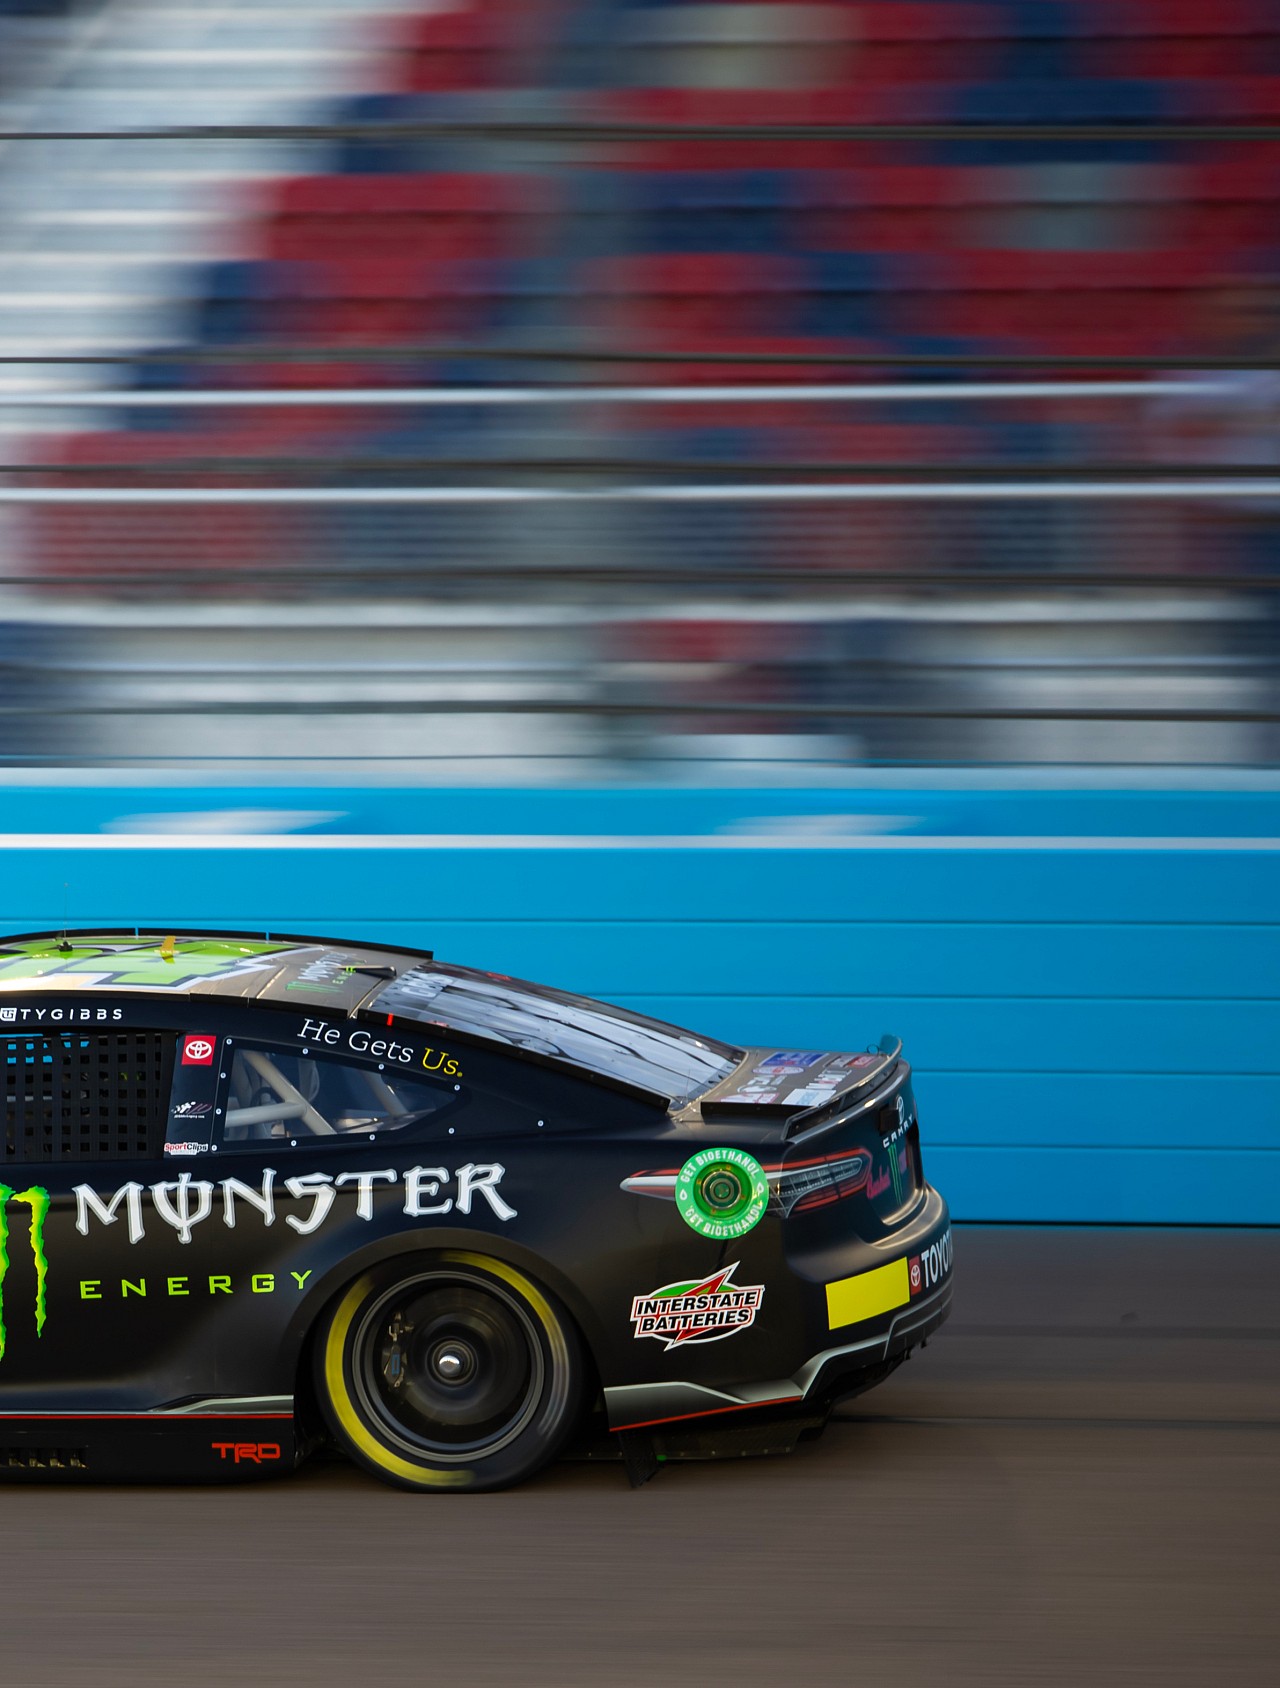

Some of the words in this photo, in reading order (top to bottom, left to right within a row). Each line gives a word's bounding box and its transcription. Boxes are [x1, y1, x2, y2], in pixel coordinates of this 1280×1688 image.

[297, 1018, 341, 1045] He
[348, 1031, 414, 1063] Gets
[421, 1047, 463, 1078] Us.
[882, 1115, 914, 1149] CAMRY
[680, 1162, 697, 1183] GET
[695, 1149, 760, 1179] BIOETHANOL
[71, 1163, 518, 1244] MONSTER
[685, 1207, 704, 1227] GET
[702, 1200, 763, 1237] BIOETHANOL
[921, 1230, 951, 1288] TOYO
[79, 1270, 312, 1299] ENERGY
[637, 1291, 757, 1315] INTERSTATE
[642, 1309, 749, 1332] BATTERIES
[211, 1443, 281, 1464] TRD
